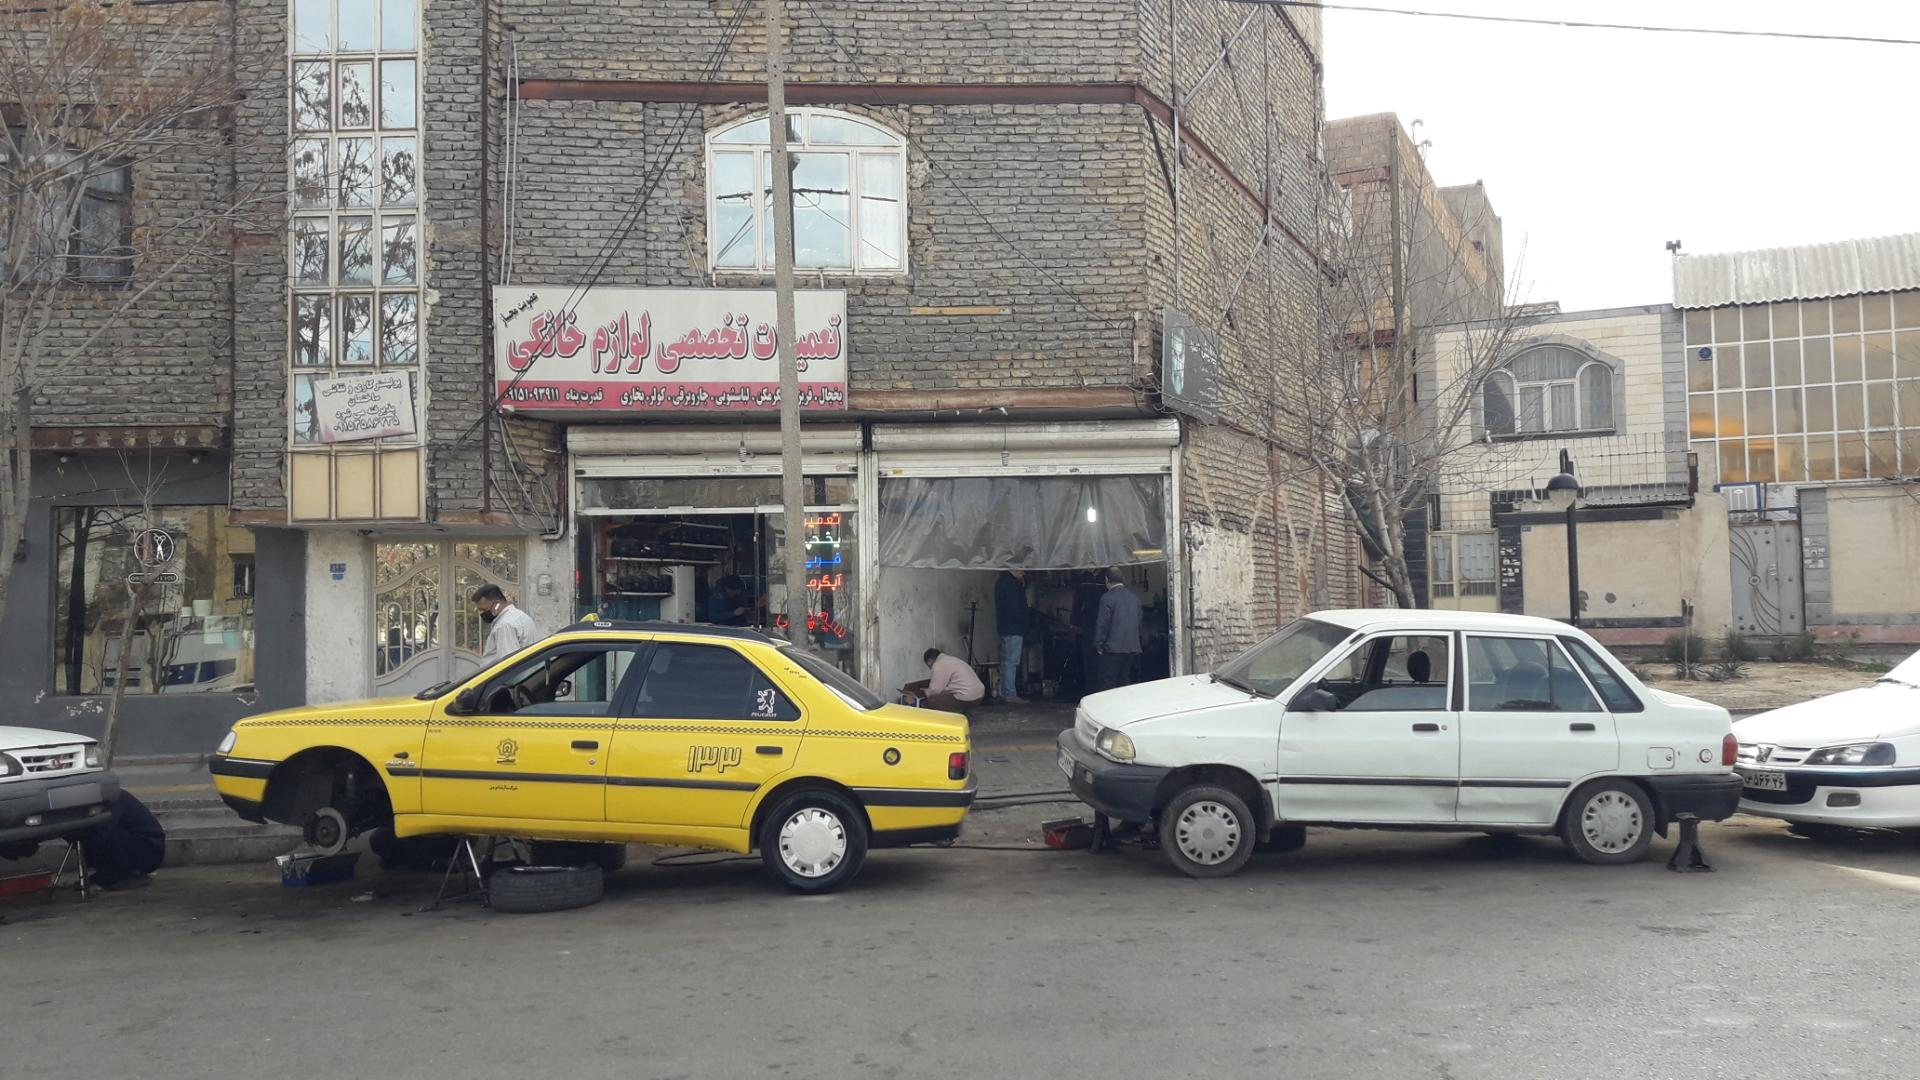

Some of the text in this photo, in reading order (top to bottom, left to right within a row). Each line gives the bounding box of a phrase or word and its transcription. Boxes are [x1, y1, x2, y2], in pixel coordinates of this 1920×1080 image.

[506, 308, 841, 374] تعمیت تخصصی لوازم خانگی
[565, 387, 580, 405] پناه
[580, 386, 603, 405] قدرت
[620, 386, 644, 406] بخاری
[649, 387, 666, 406] کولر
[673, 385, 709, 405] جاروبرقی
[714, 386, 750, 406] لباسشویی
[818, 386, 843, 406] یخچال
[806, 574, 842, 591] آبگرم
[687, 745, 742, 774] ۱۳۳
